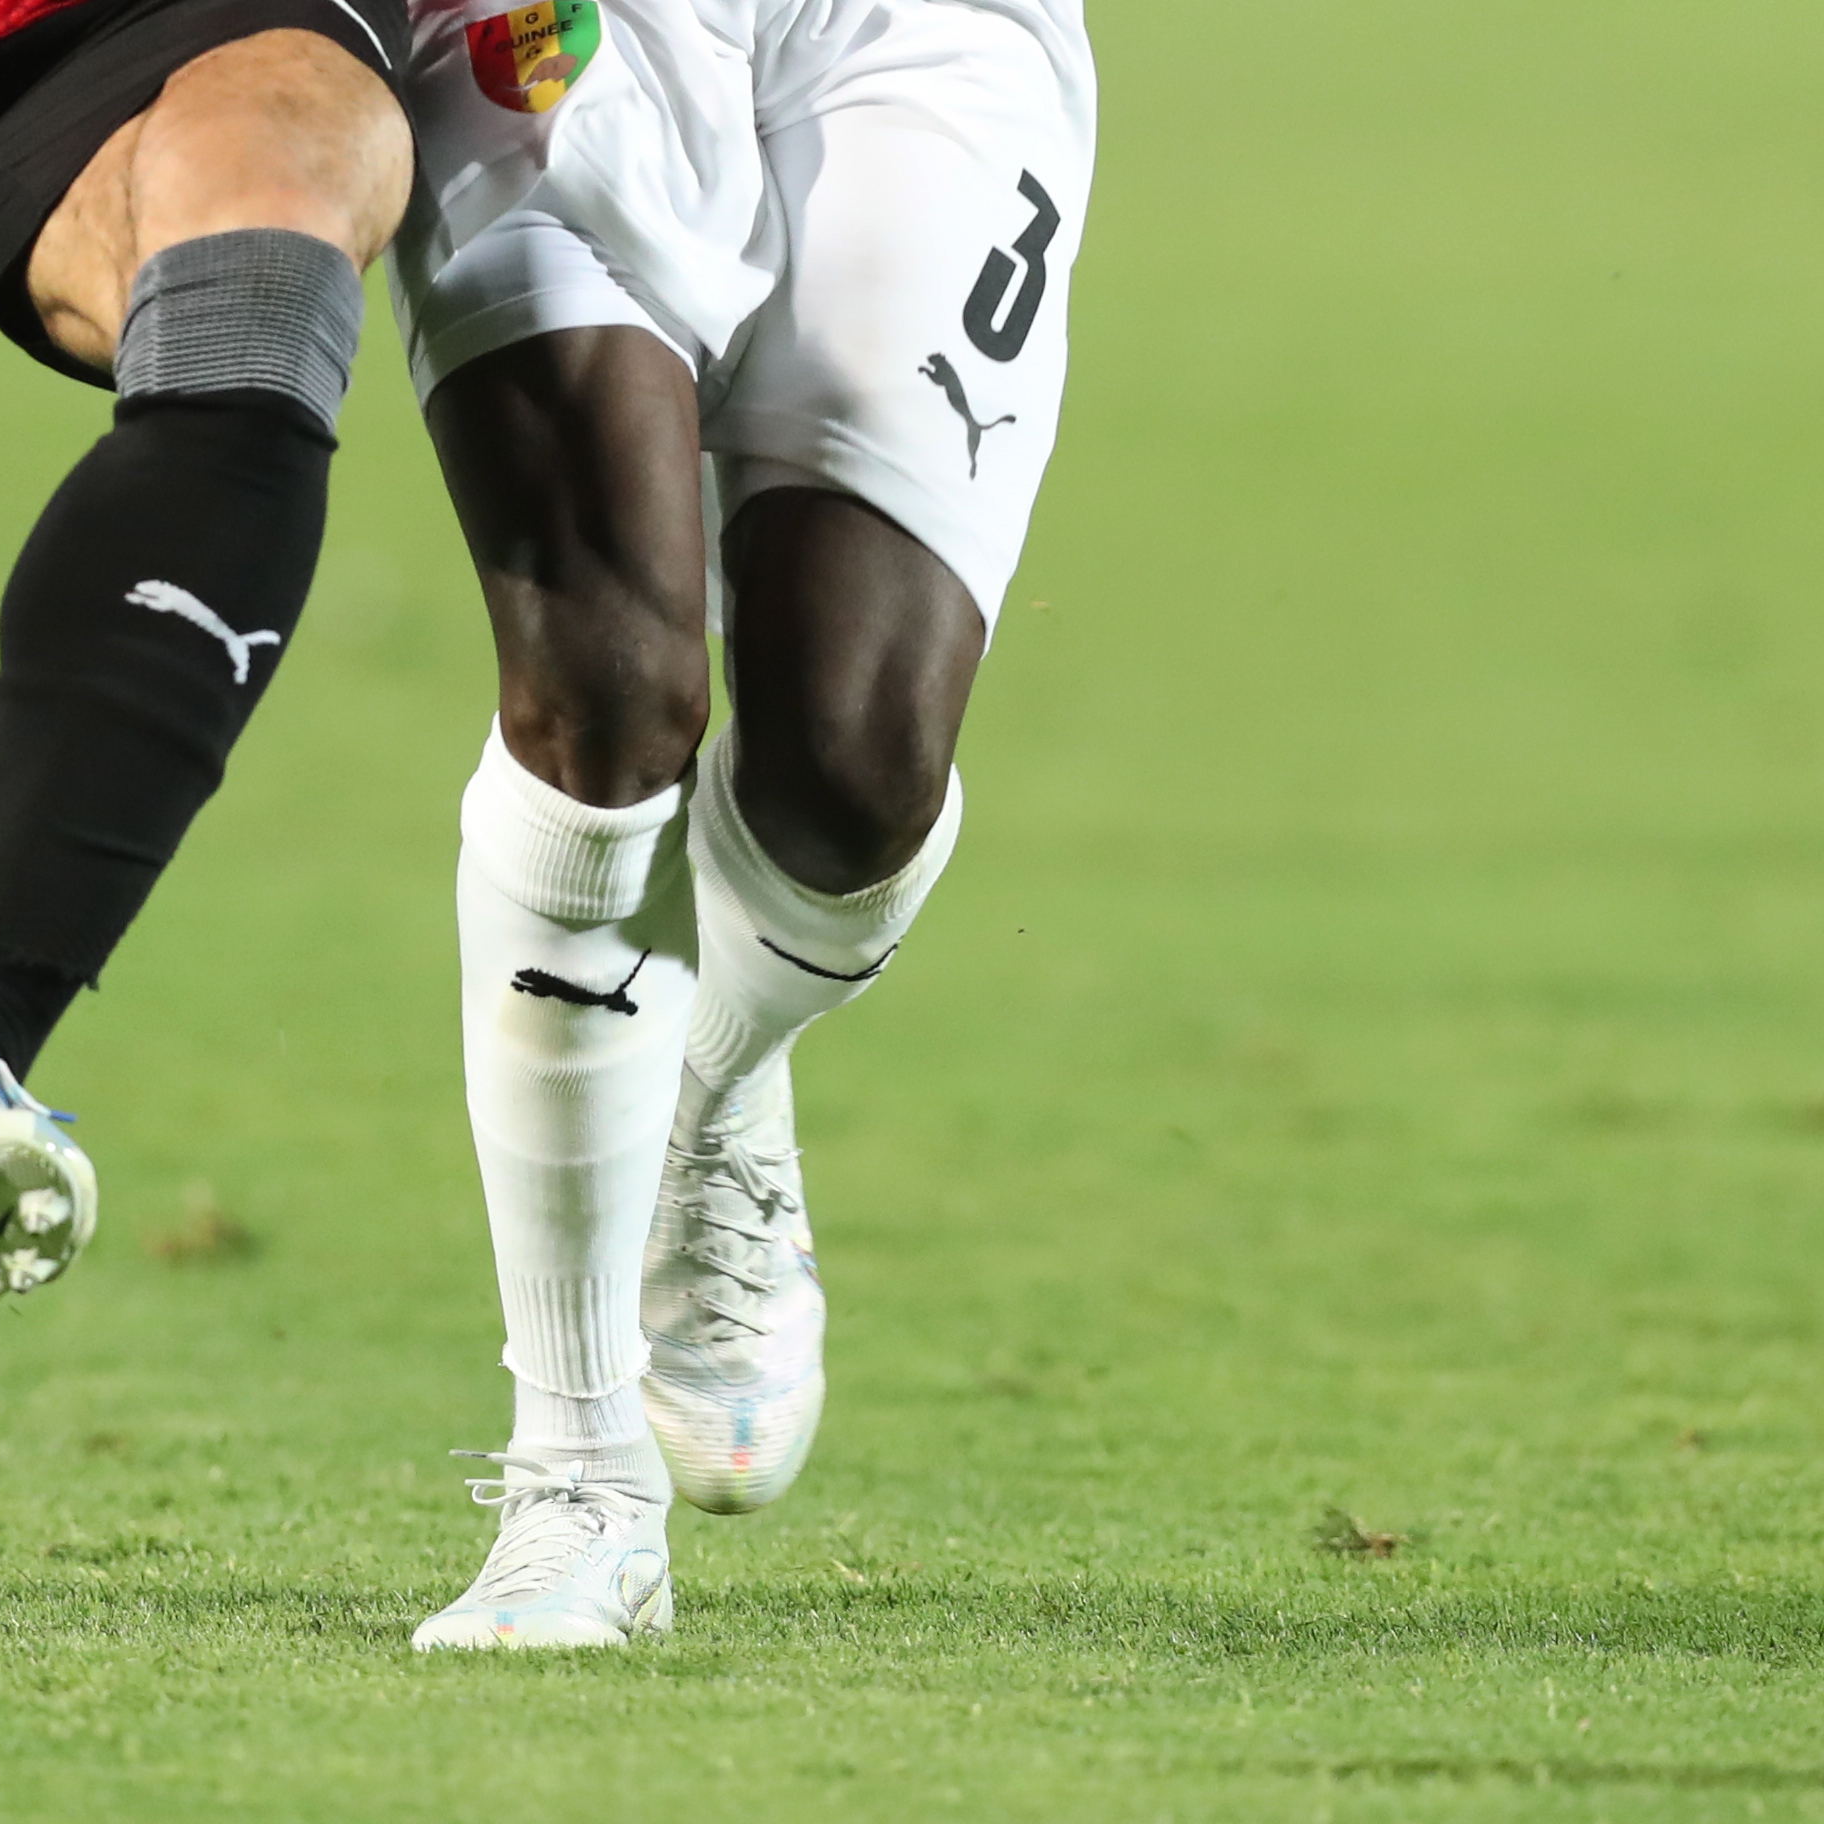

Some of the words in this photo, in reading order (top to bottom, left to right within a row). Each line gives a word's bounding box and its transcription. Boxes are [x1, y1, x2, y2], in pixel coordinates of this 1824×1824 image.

[524, 12, 539, 25] G
[571, 3, 583, 13] F
[493, 19, 574, 55] GUINEE
[962, 167, 1061, 363] 3
